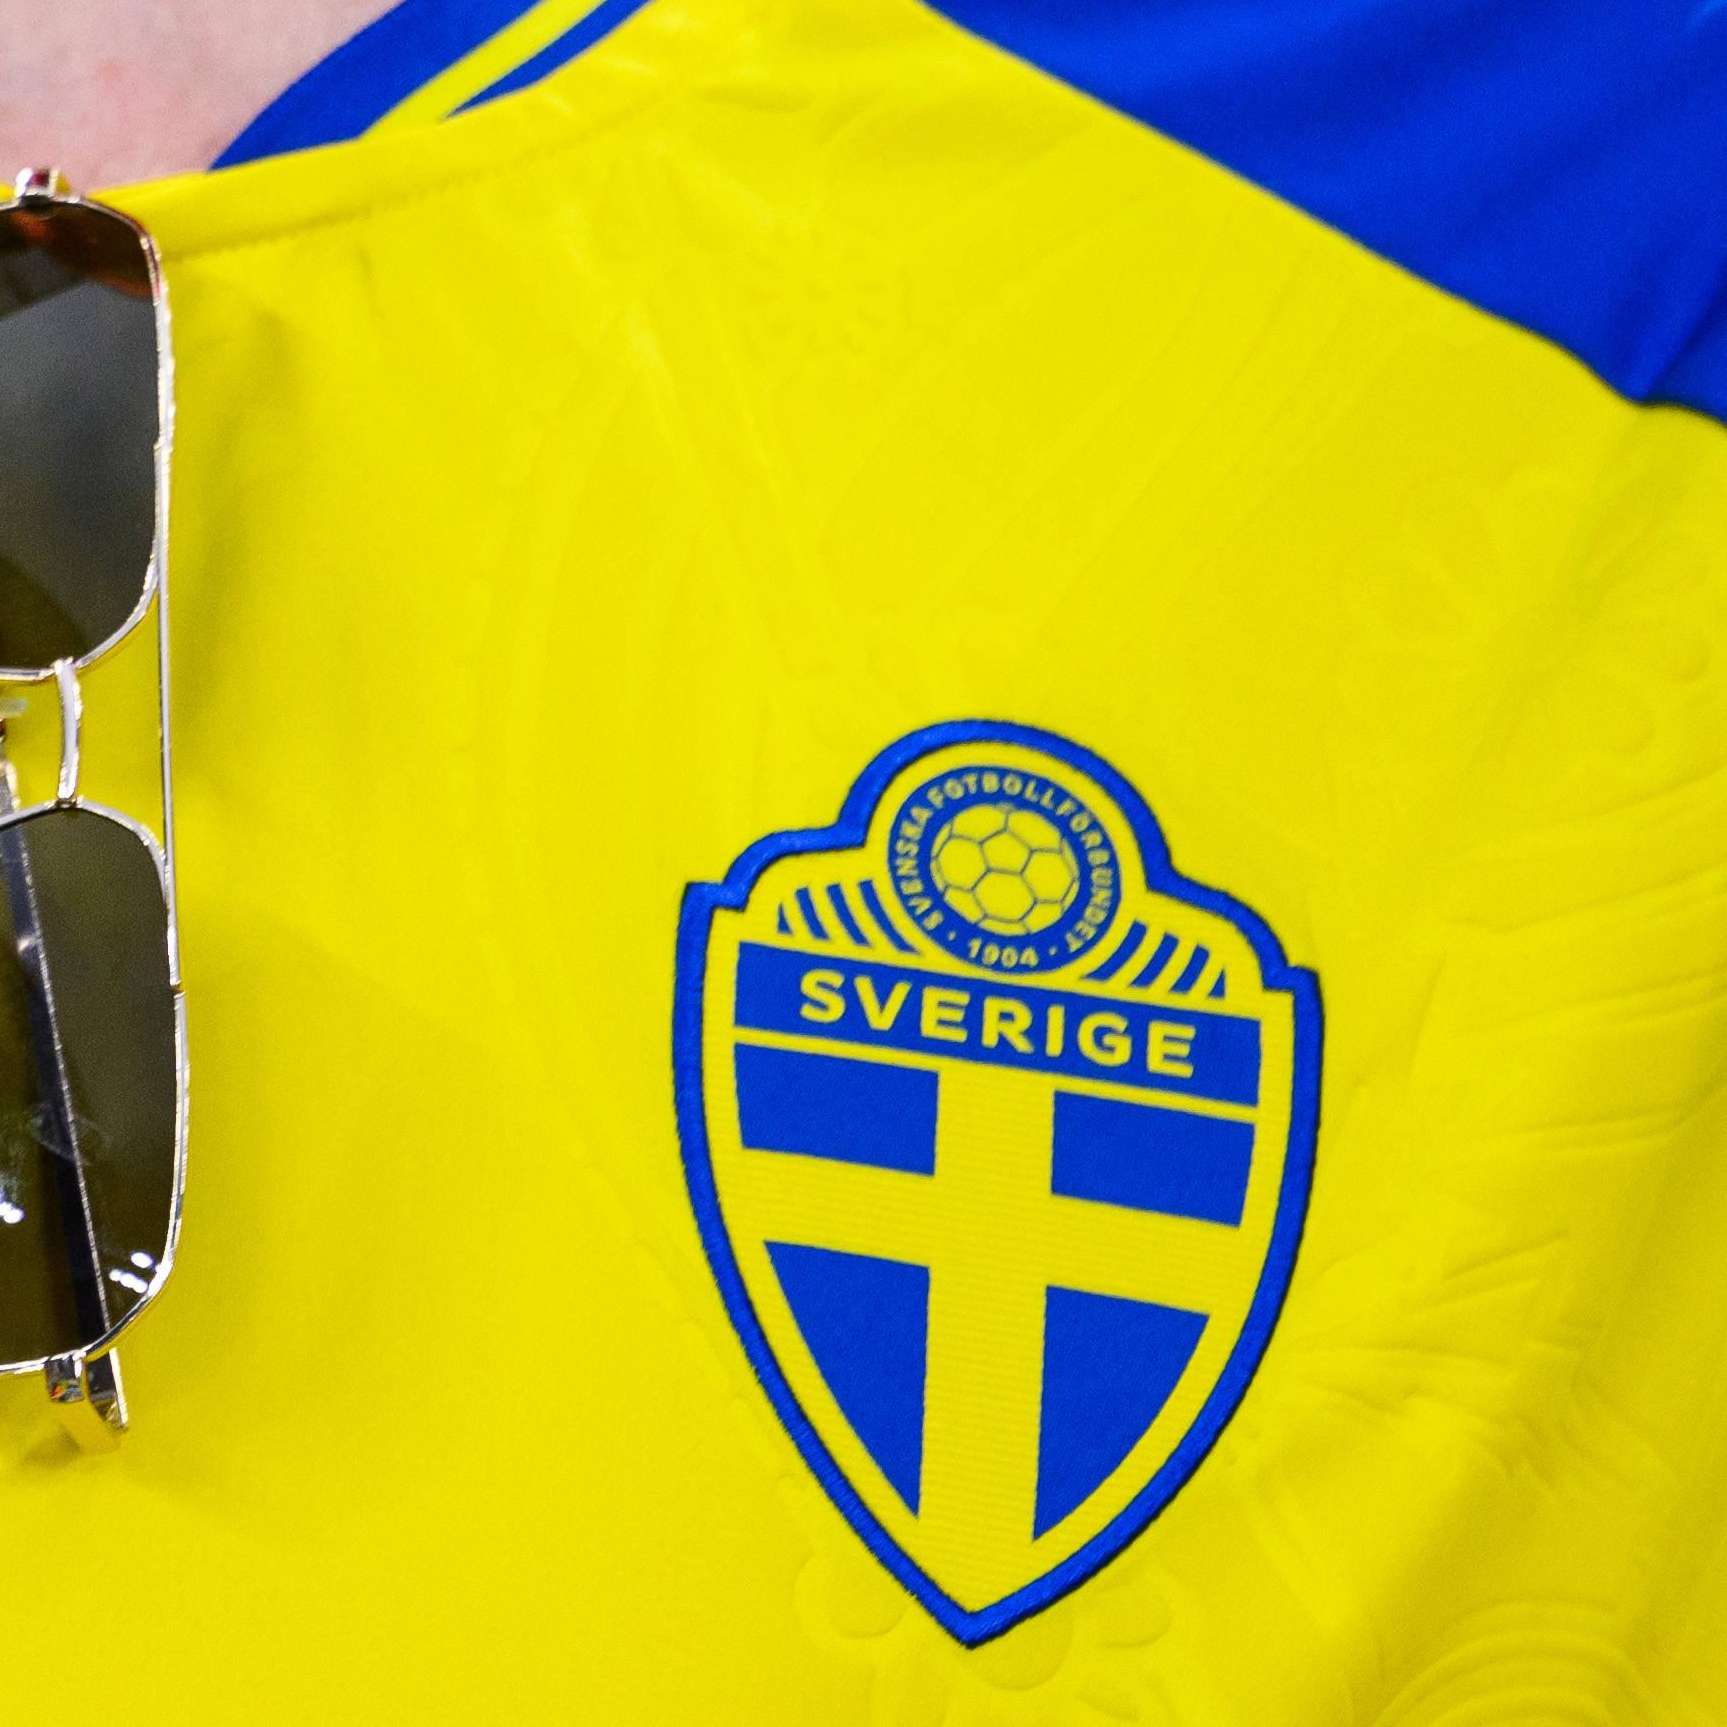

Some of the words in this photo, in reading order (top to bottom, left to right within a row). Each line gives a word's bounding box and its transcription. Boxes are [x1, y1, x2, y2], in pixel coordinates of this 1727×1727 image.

[895, 806, 944, 931] SVENSKA
[968, 937, 1040, 969] 1904
[799, 968, 1197, 1079] SVERIGE
